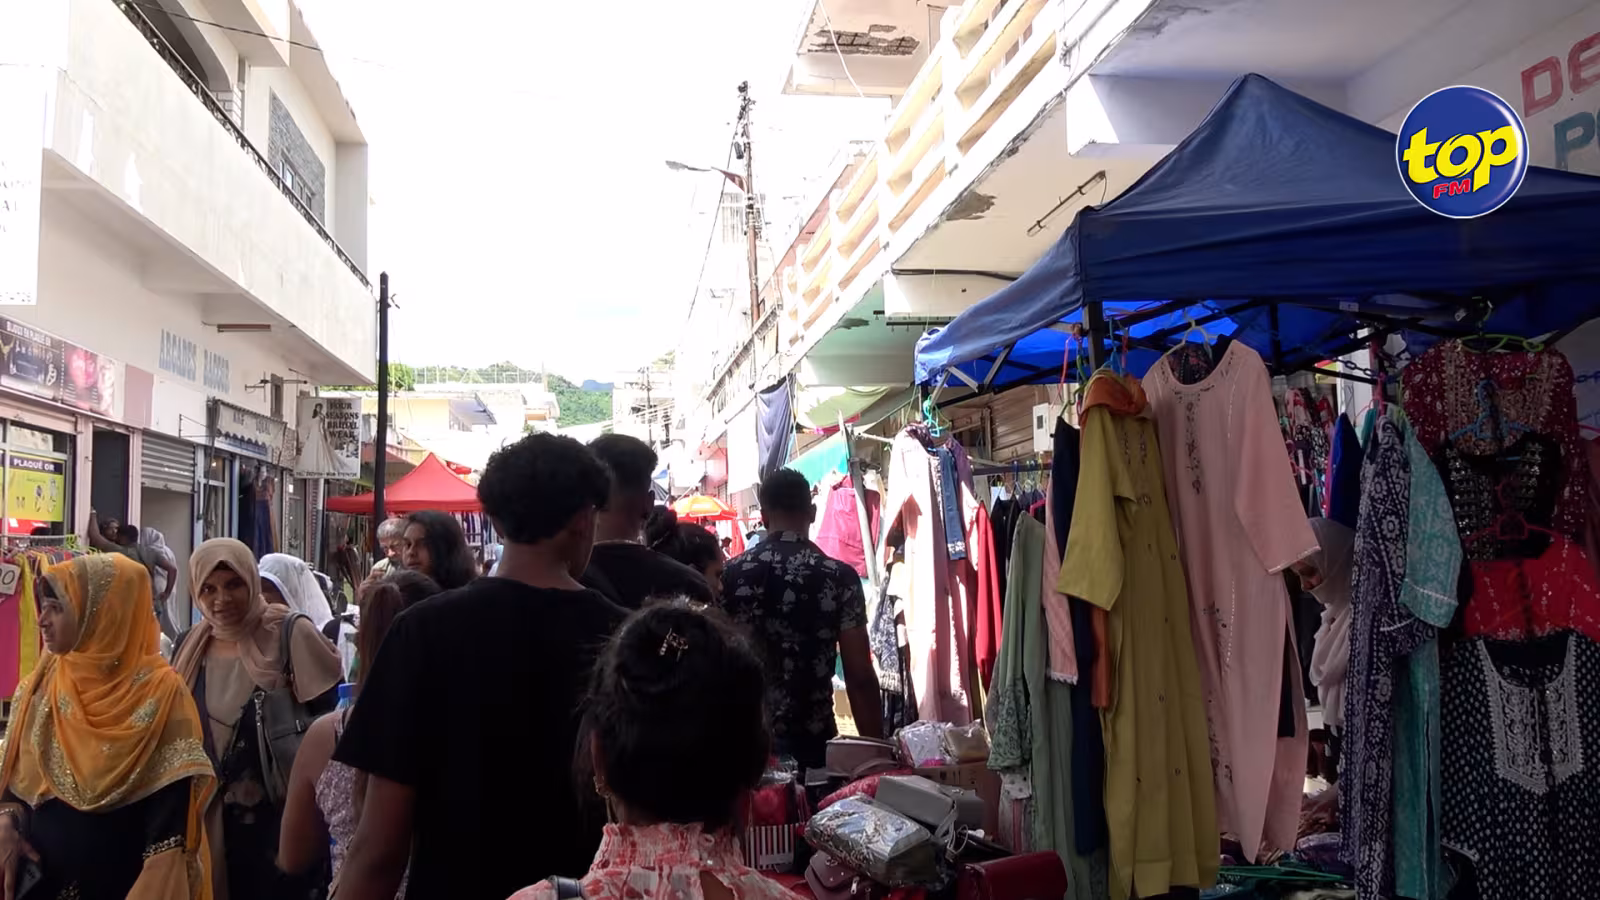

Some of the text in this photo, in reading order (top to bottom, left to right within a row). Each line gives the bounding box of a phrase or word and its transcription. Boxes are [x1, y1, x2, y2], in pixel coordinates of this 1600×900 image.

[1554, 108, 1600, 172] P
[158, 328, 197, 382] ARCADES
[329, 402, 353, 411] FOUR
[325, 411, 360, 420] SEASONS
[327, 421, 359, 430] BRIDAL
[329, 430, 355, 439] WEAR
[13, 458, 55, 472] PLAQUÉ OR
